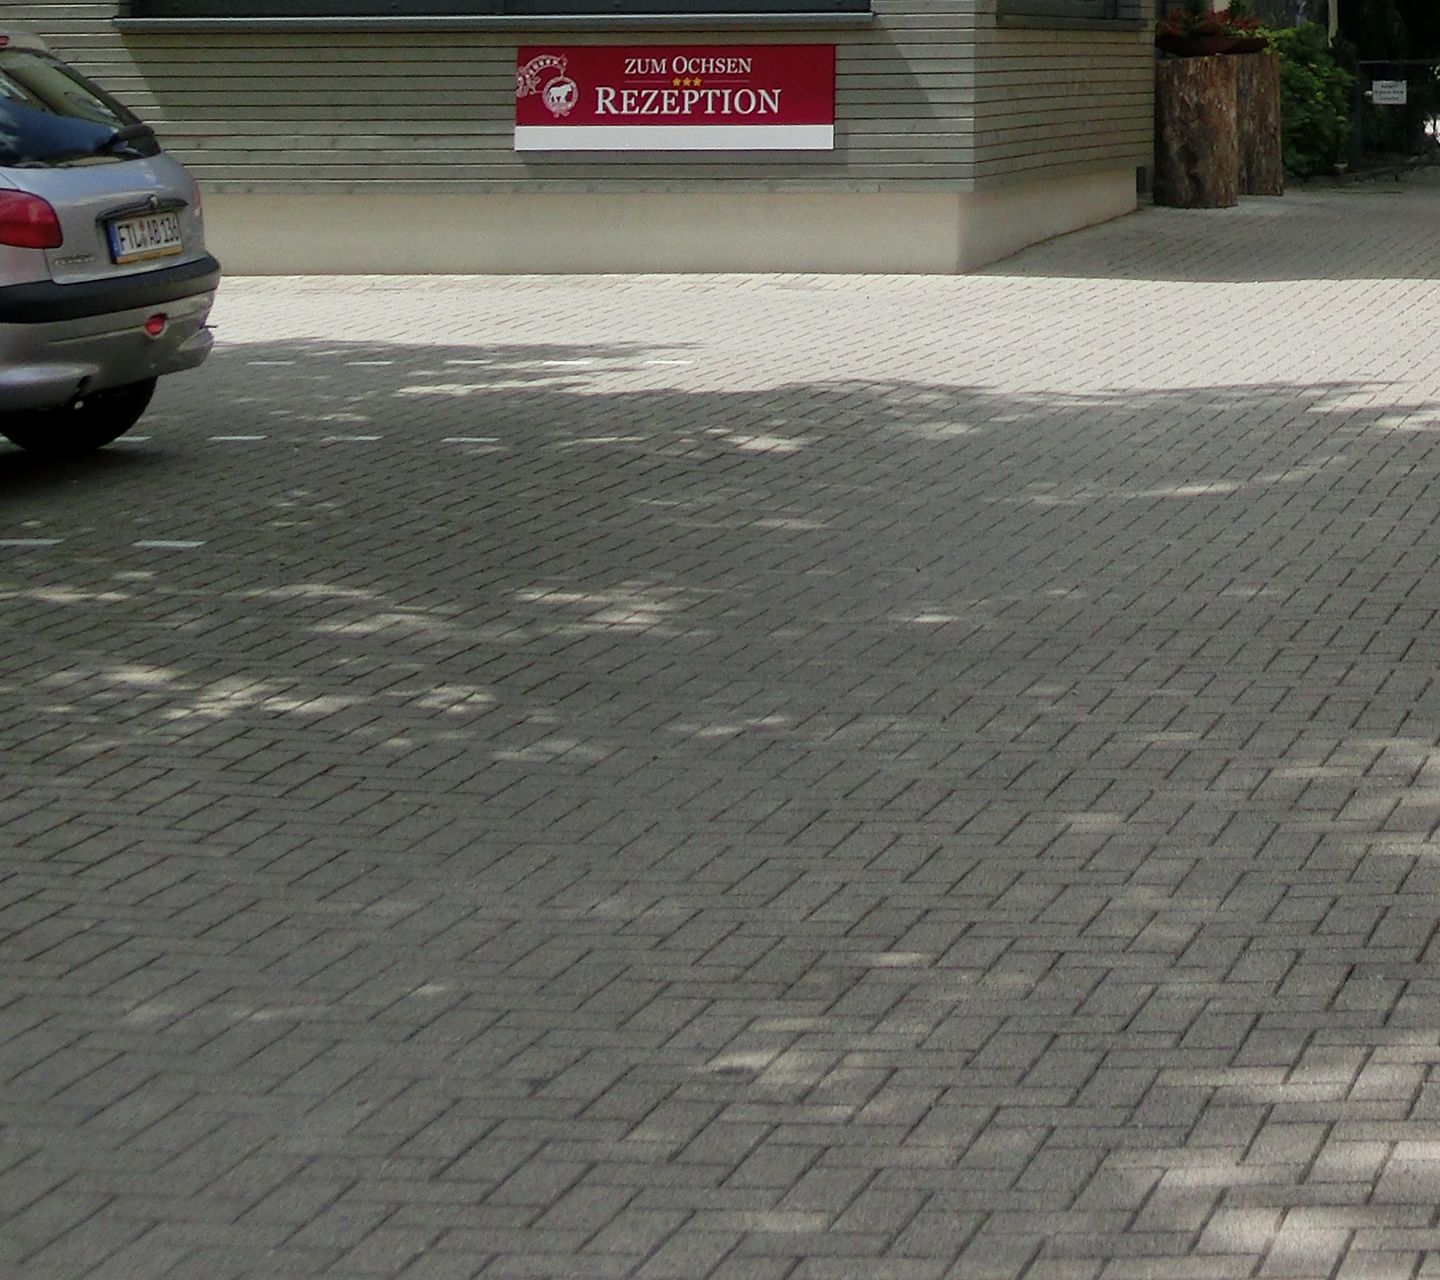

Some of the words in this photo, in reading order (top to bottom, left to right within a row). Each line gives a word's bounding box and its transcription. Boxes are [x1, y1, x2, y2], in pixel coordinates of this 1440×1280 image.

[624, 57, 667, 75] ZUM
[671, 55, 753, 74] OCHSEN
[594, 86, 782, 115] REZEPTION
